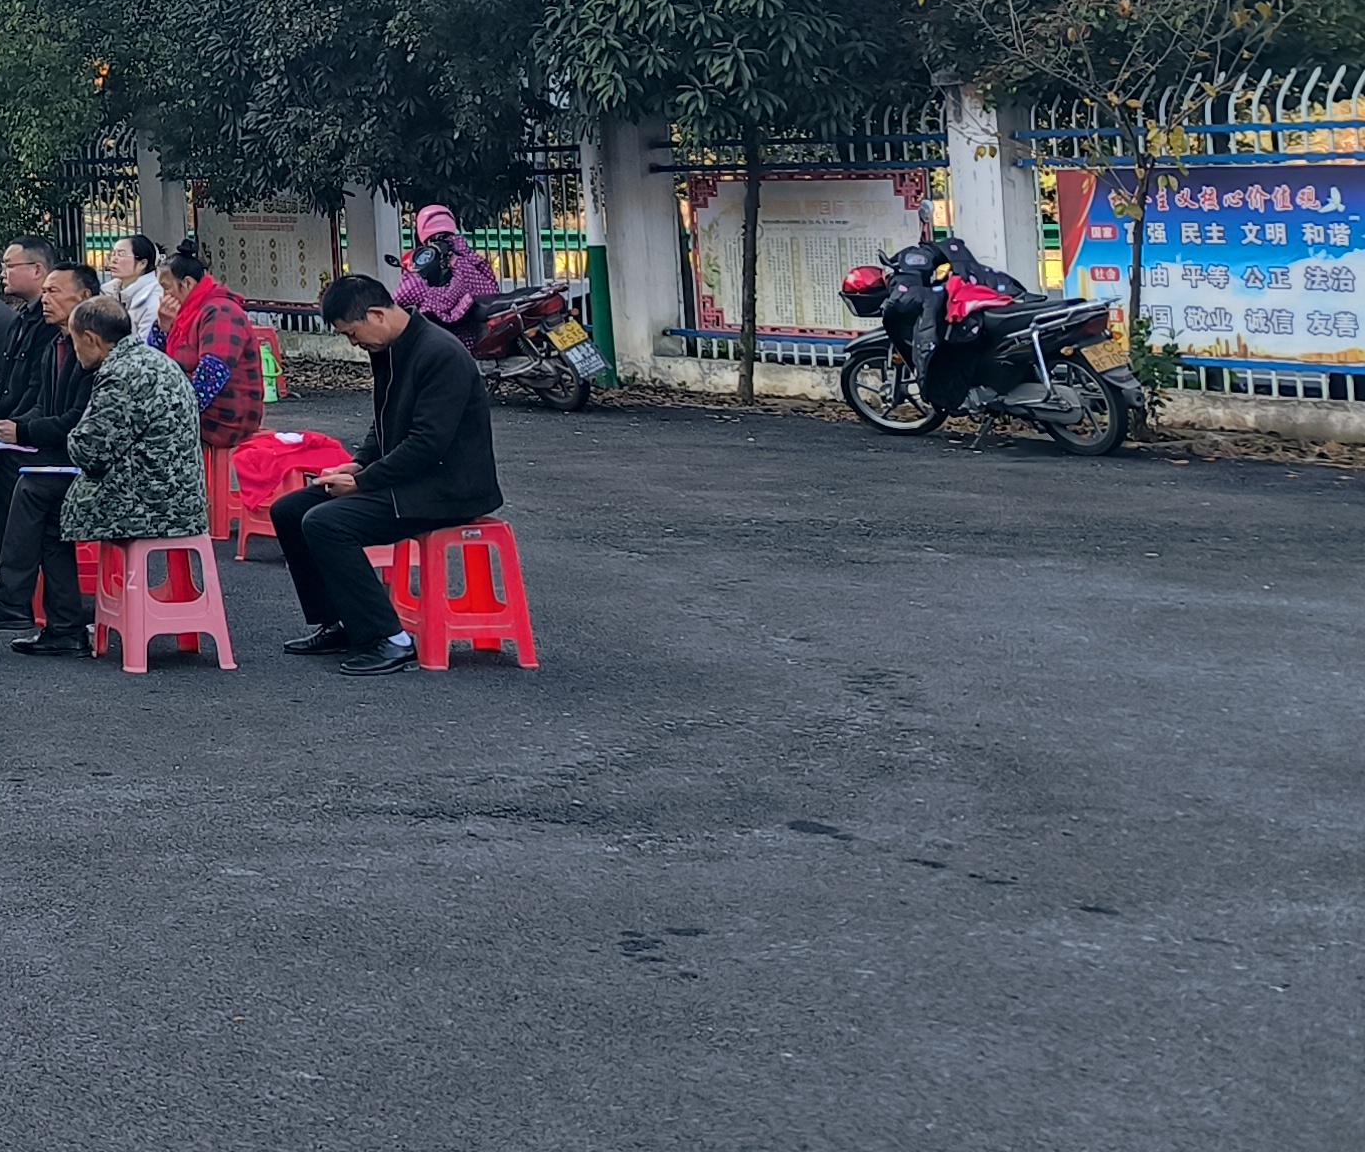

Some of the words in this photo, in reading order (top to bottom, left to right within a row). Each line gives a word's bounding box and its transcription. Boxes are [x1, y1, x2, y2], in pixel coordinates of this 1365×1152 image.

[1090, 227, 1114, 239] 国家
[1180, 222, 1228, 245] 民主
[1240, 222, 1287, 246] 文明
[1302, 222, 1352, 247] 和谐
[1095, 267, 1117, 279] 社会
[1182, 263, 1230, 289] 平等
[1241, 266, 1292, 290] 公正
[1304, 266, 1357, 293] 法治
[1184, 305, 1234, 332] 敬业
[1245, 308, 1295, 335] 诚信
[1307, 310, 1360, 338] 友善
